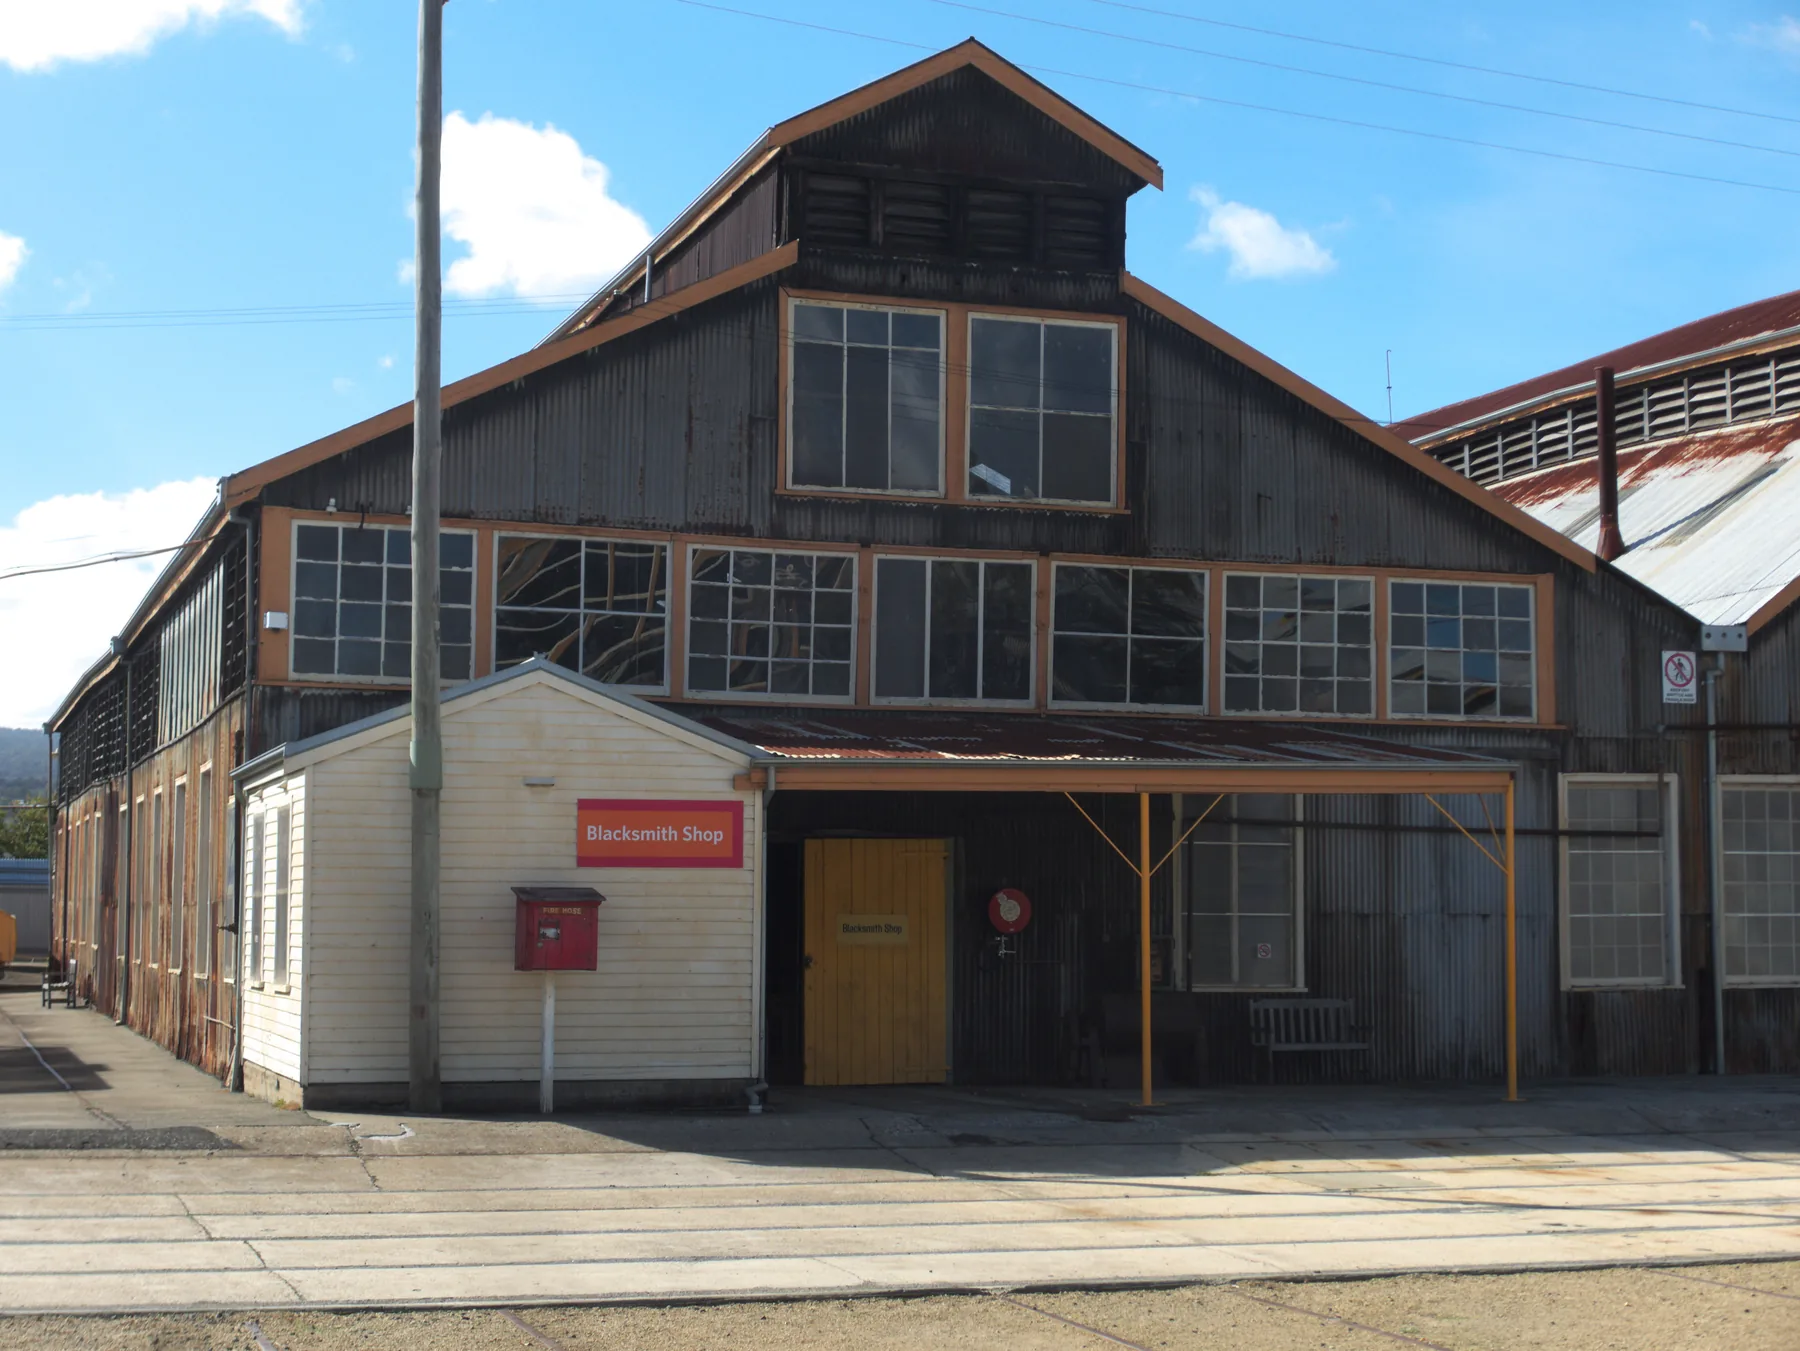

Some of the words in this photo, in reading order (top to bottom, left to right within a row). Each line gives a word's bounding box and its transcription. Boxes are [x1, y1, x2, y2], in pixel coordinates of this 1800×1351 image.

[587, 825, 678, 841] Blacksmith
[682, 826, 724, 845] Shop
[562, 907, 582, 915] HOSE
[842, 923, 883, 933] Blacksmith
[884, 923, 903, 935] Shop
